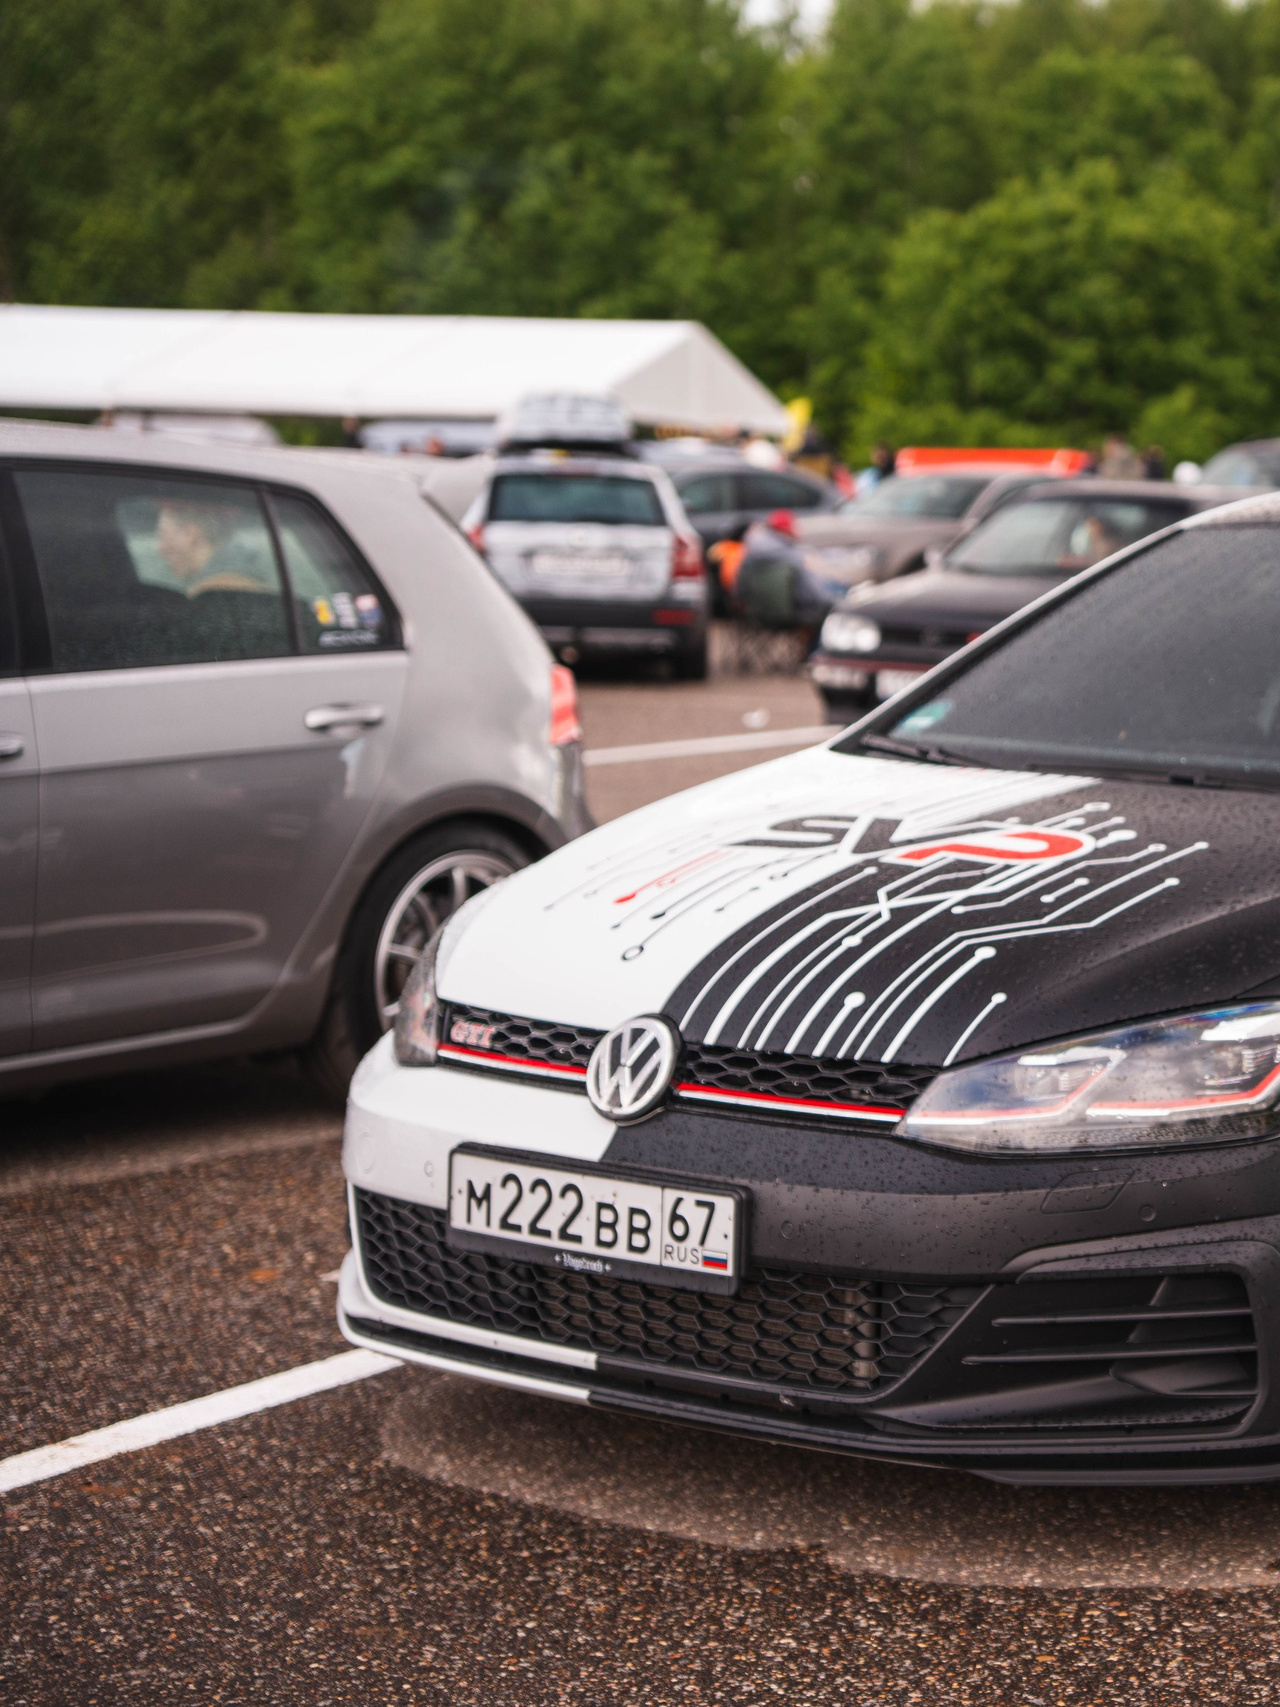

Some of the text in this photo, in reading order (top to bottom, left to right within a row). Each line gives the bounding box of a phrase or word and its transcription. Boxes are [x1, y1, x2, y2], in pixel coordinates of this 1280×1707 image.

[450, 1021, 496, 1048] GTI
[668, 1197, 716, 1246] 67
[664, 1245, 700, 1265] RUS
